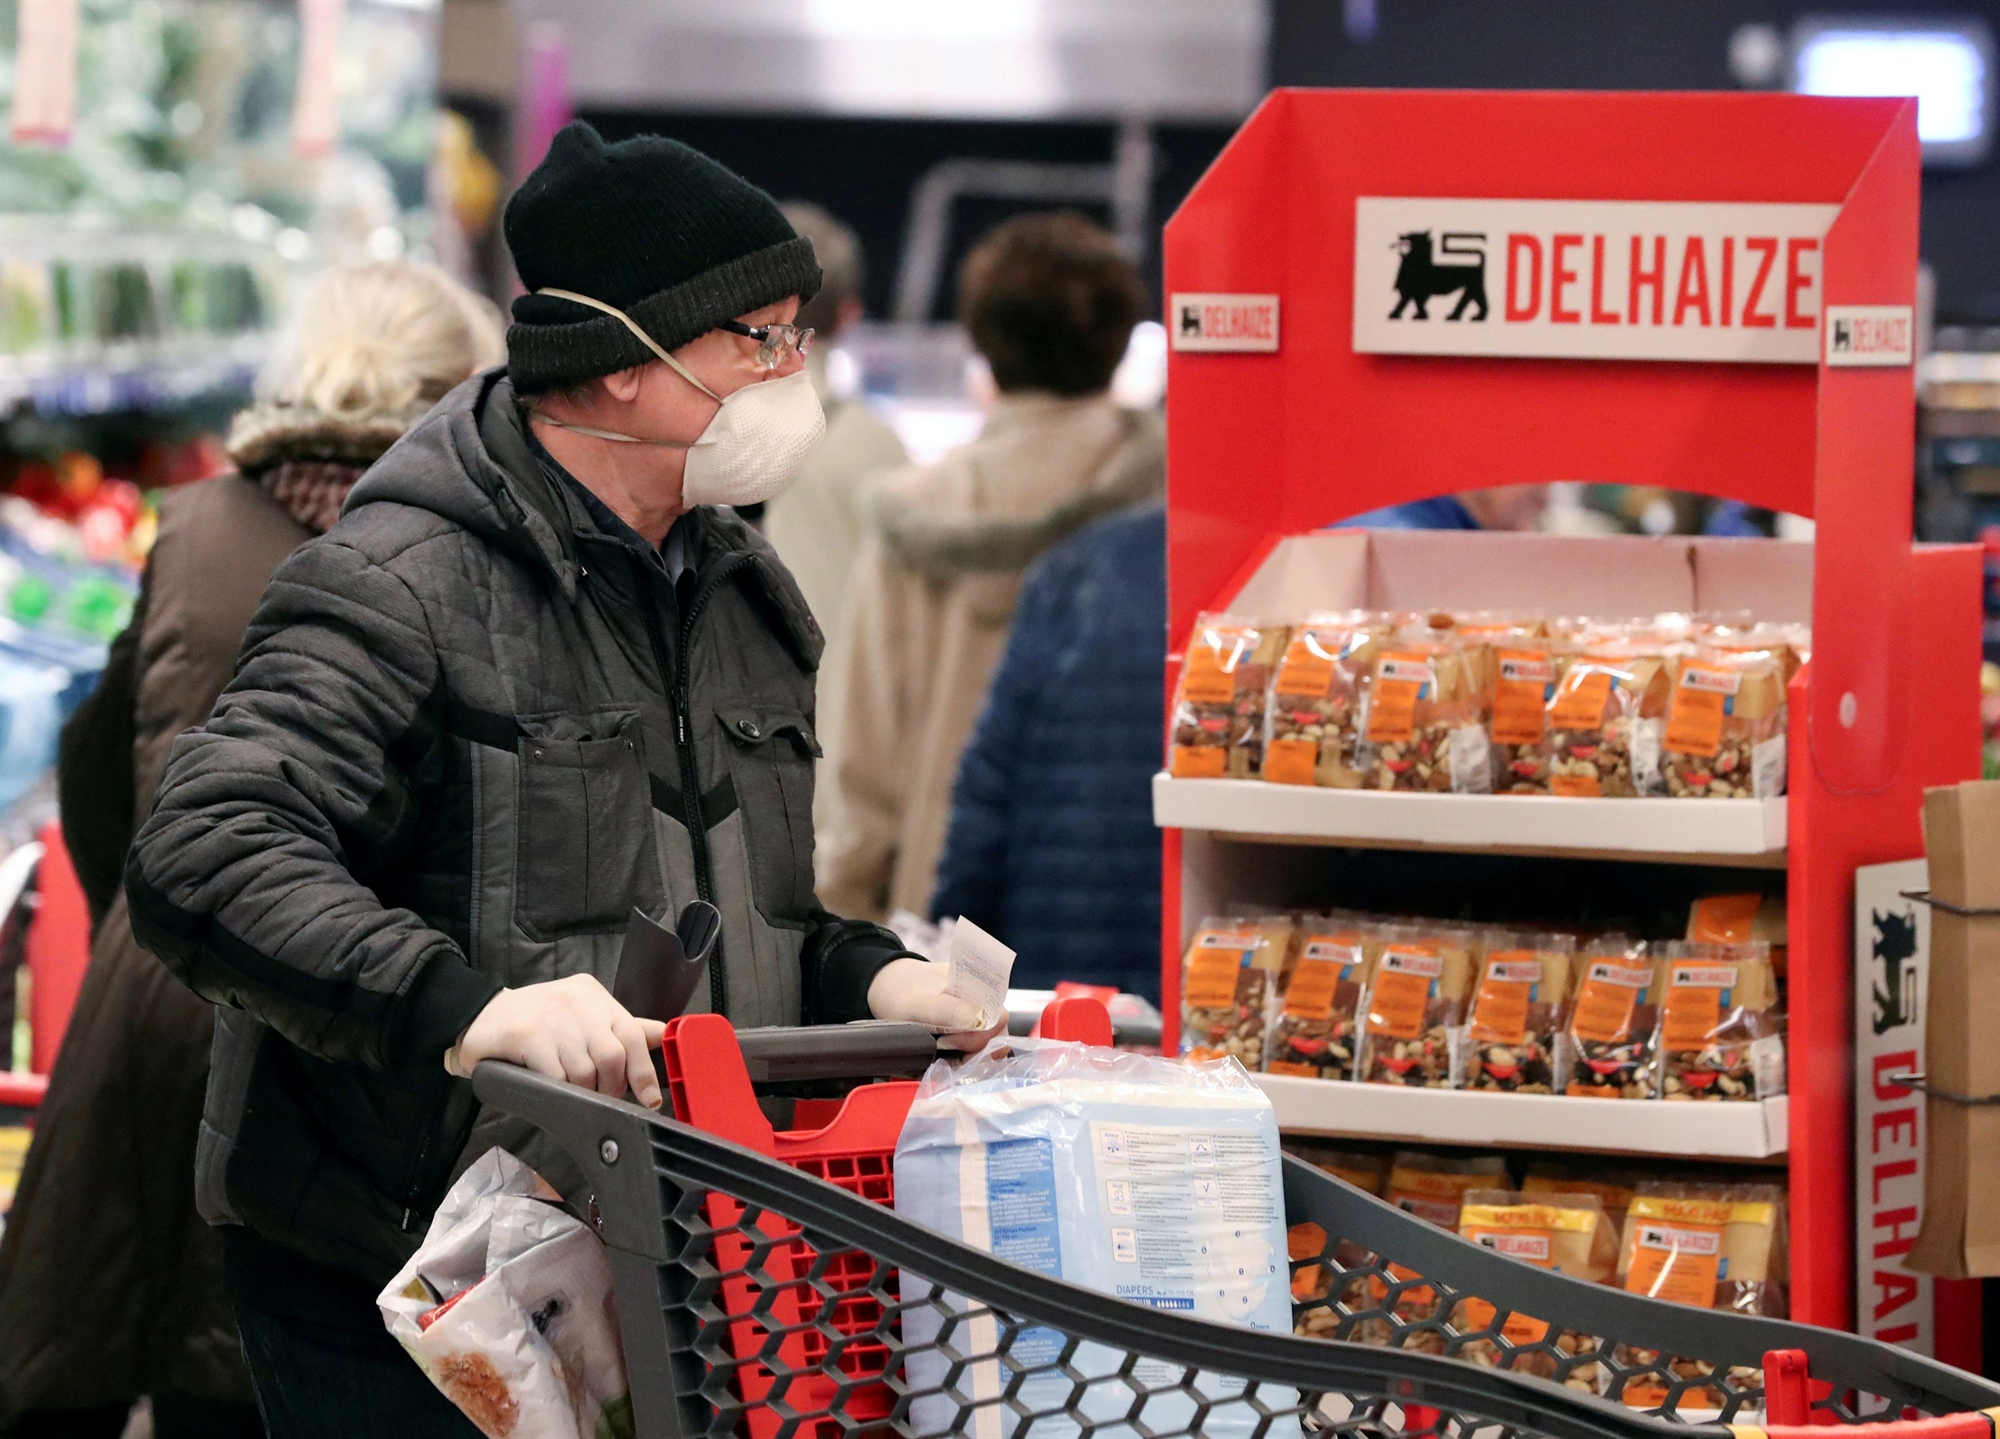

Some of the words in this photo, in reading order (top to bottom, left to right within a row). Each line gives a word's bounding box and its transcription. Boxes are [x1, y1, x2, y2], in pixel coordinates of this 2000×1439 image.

[1504, 233, 1819, 329] DELHAIZE
[1204, 305, 1272, 339] DELHAIZE
[1853, 318, 1907, 352] DELHAIZE
[1116, 1284, 1154, 1295] DIAPERS
